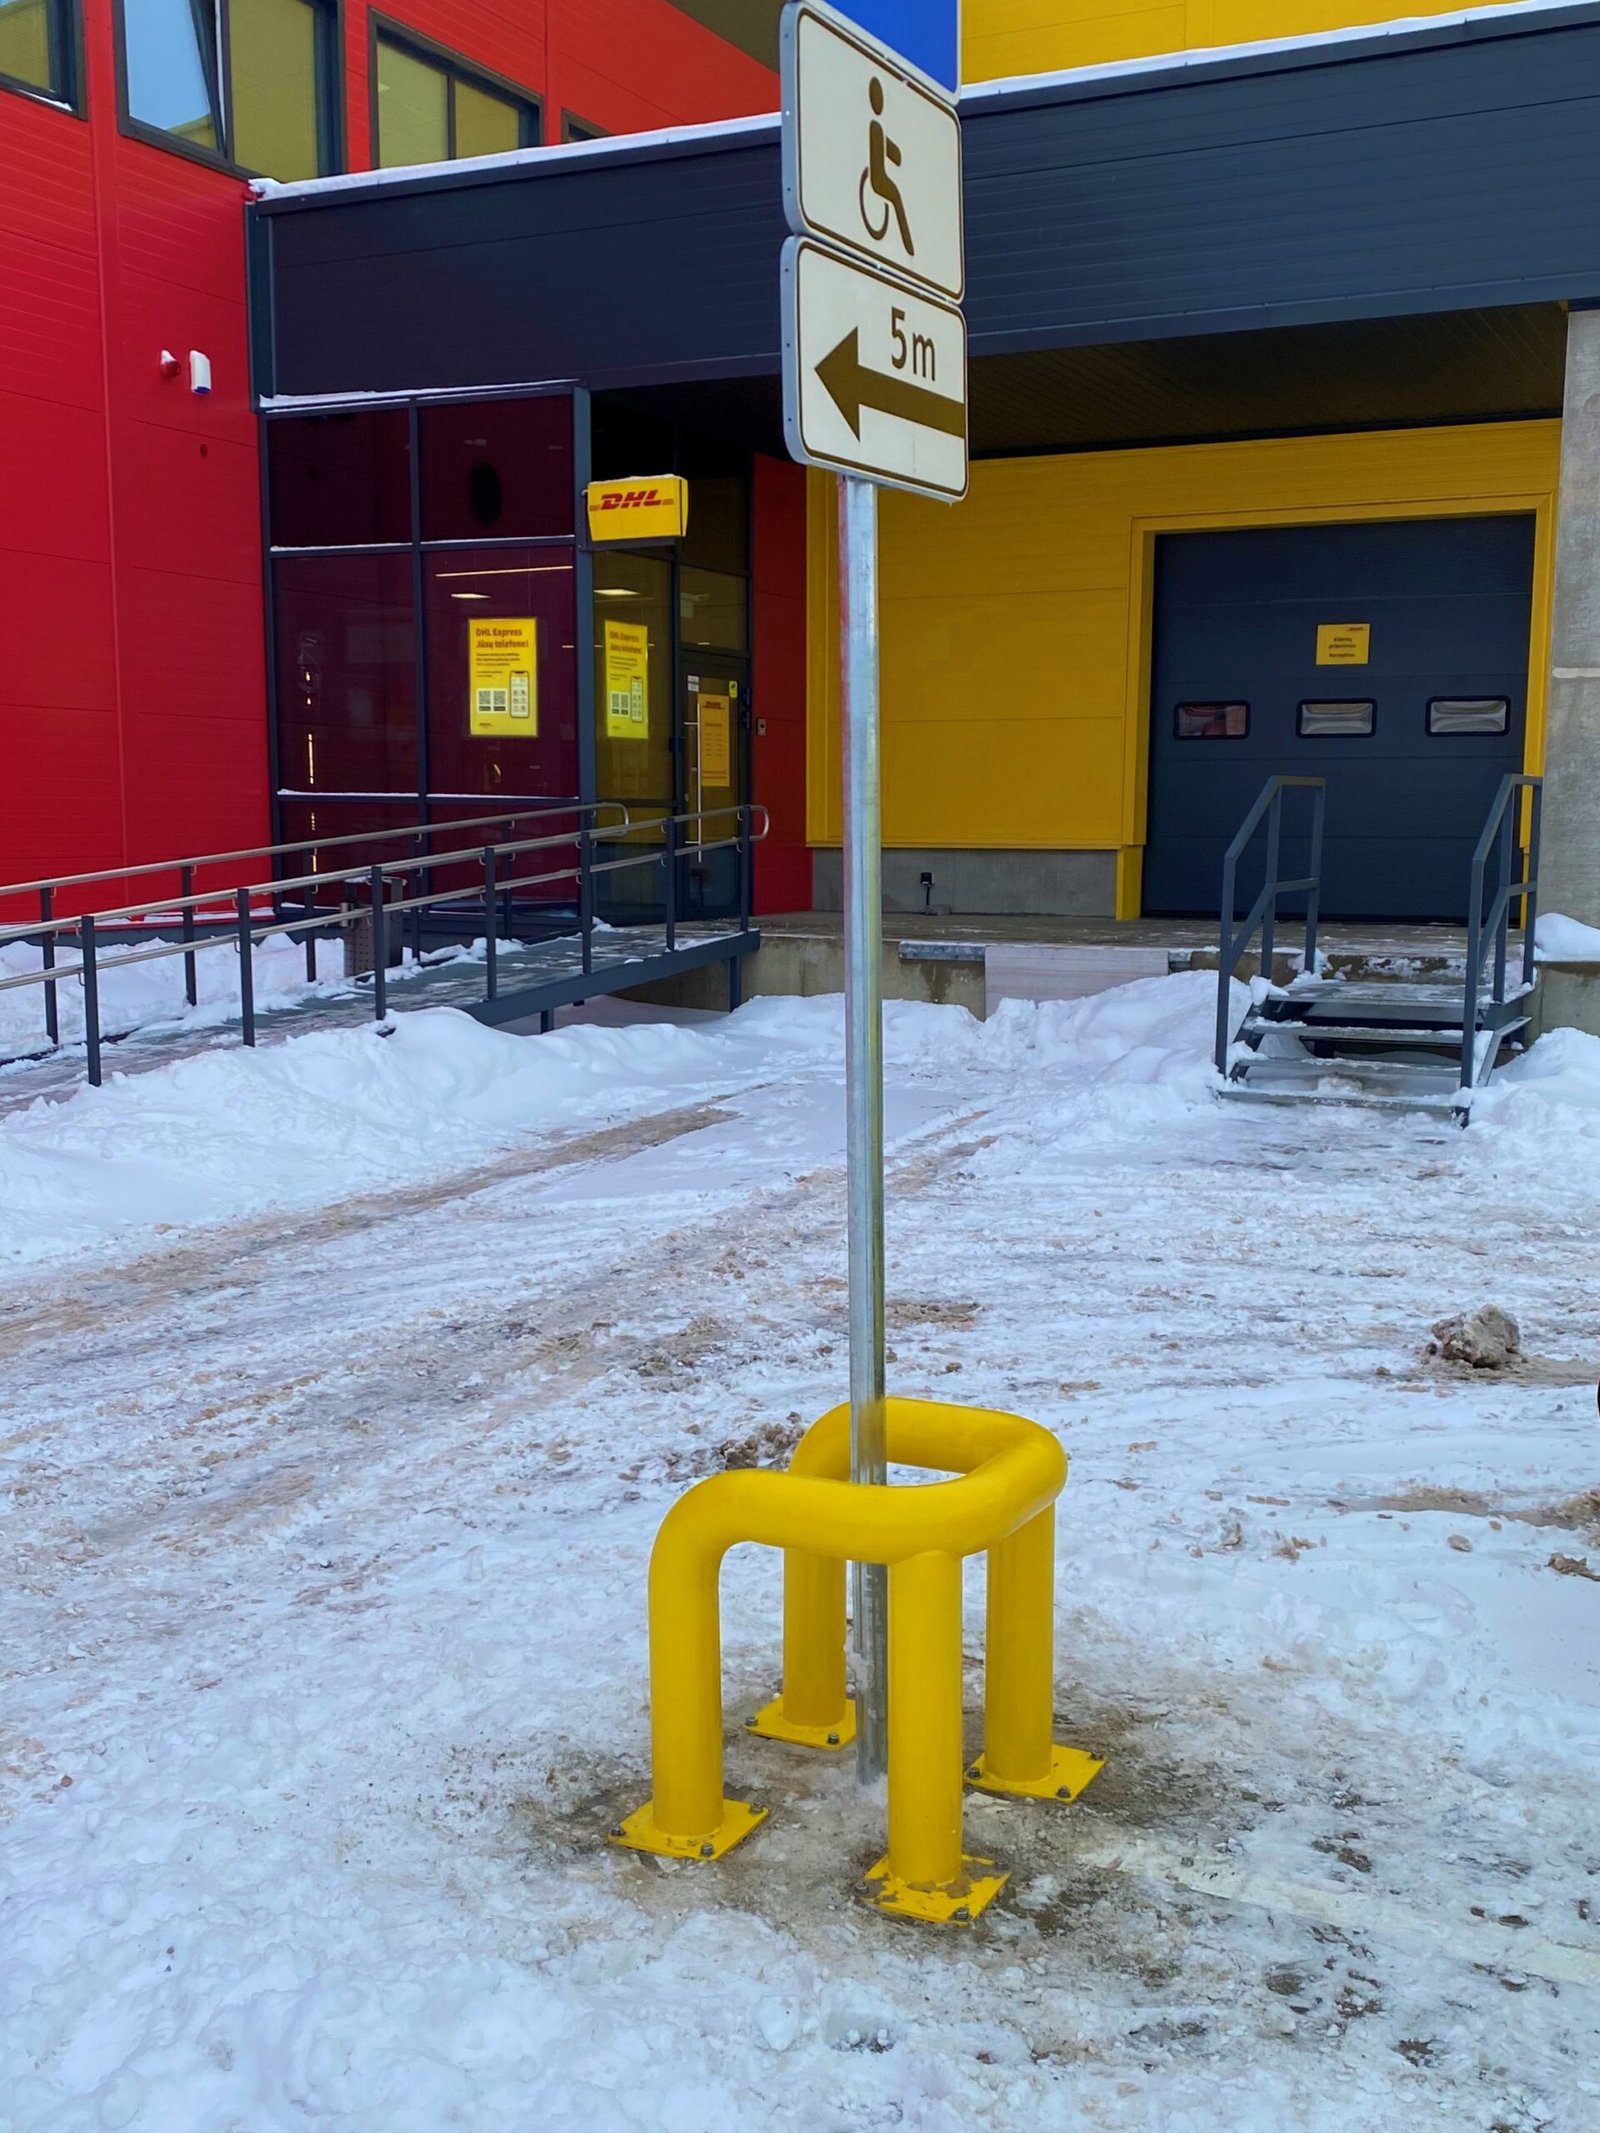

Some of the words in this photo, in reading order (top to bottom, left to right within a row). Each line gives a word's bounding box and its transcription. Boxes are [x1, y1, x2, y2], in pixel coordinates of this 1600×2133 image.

[600, 489, 662, 511] DHL
[476, 628, 491, 637] DHL
[492, 628, 523, 638] Express
